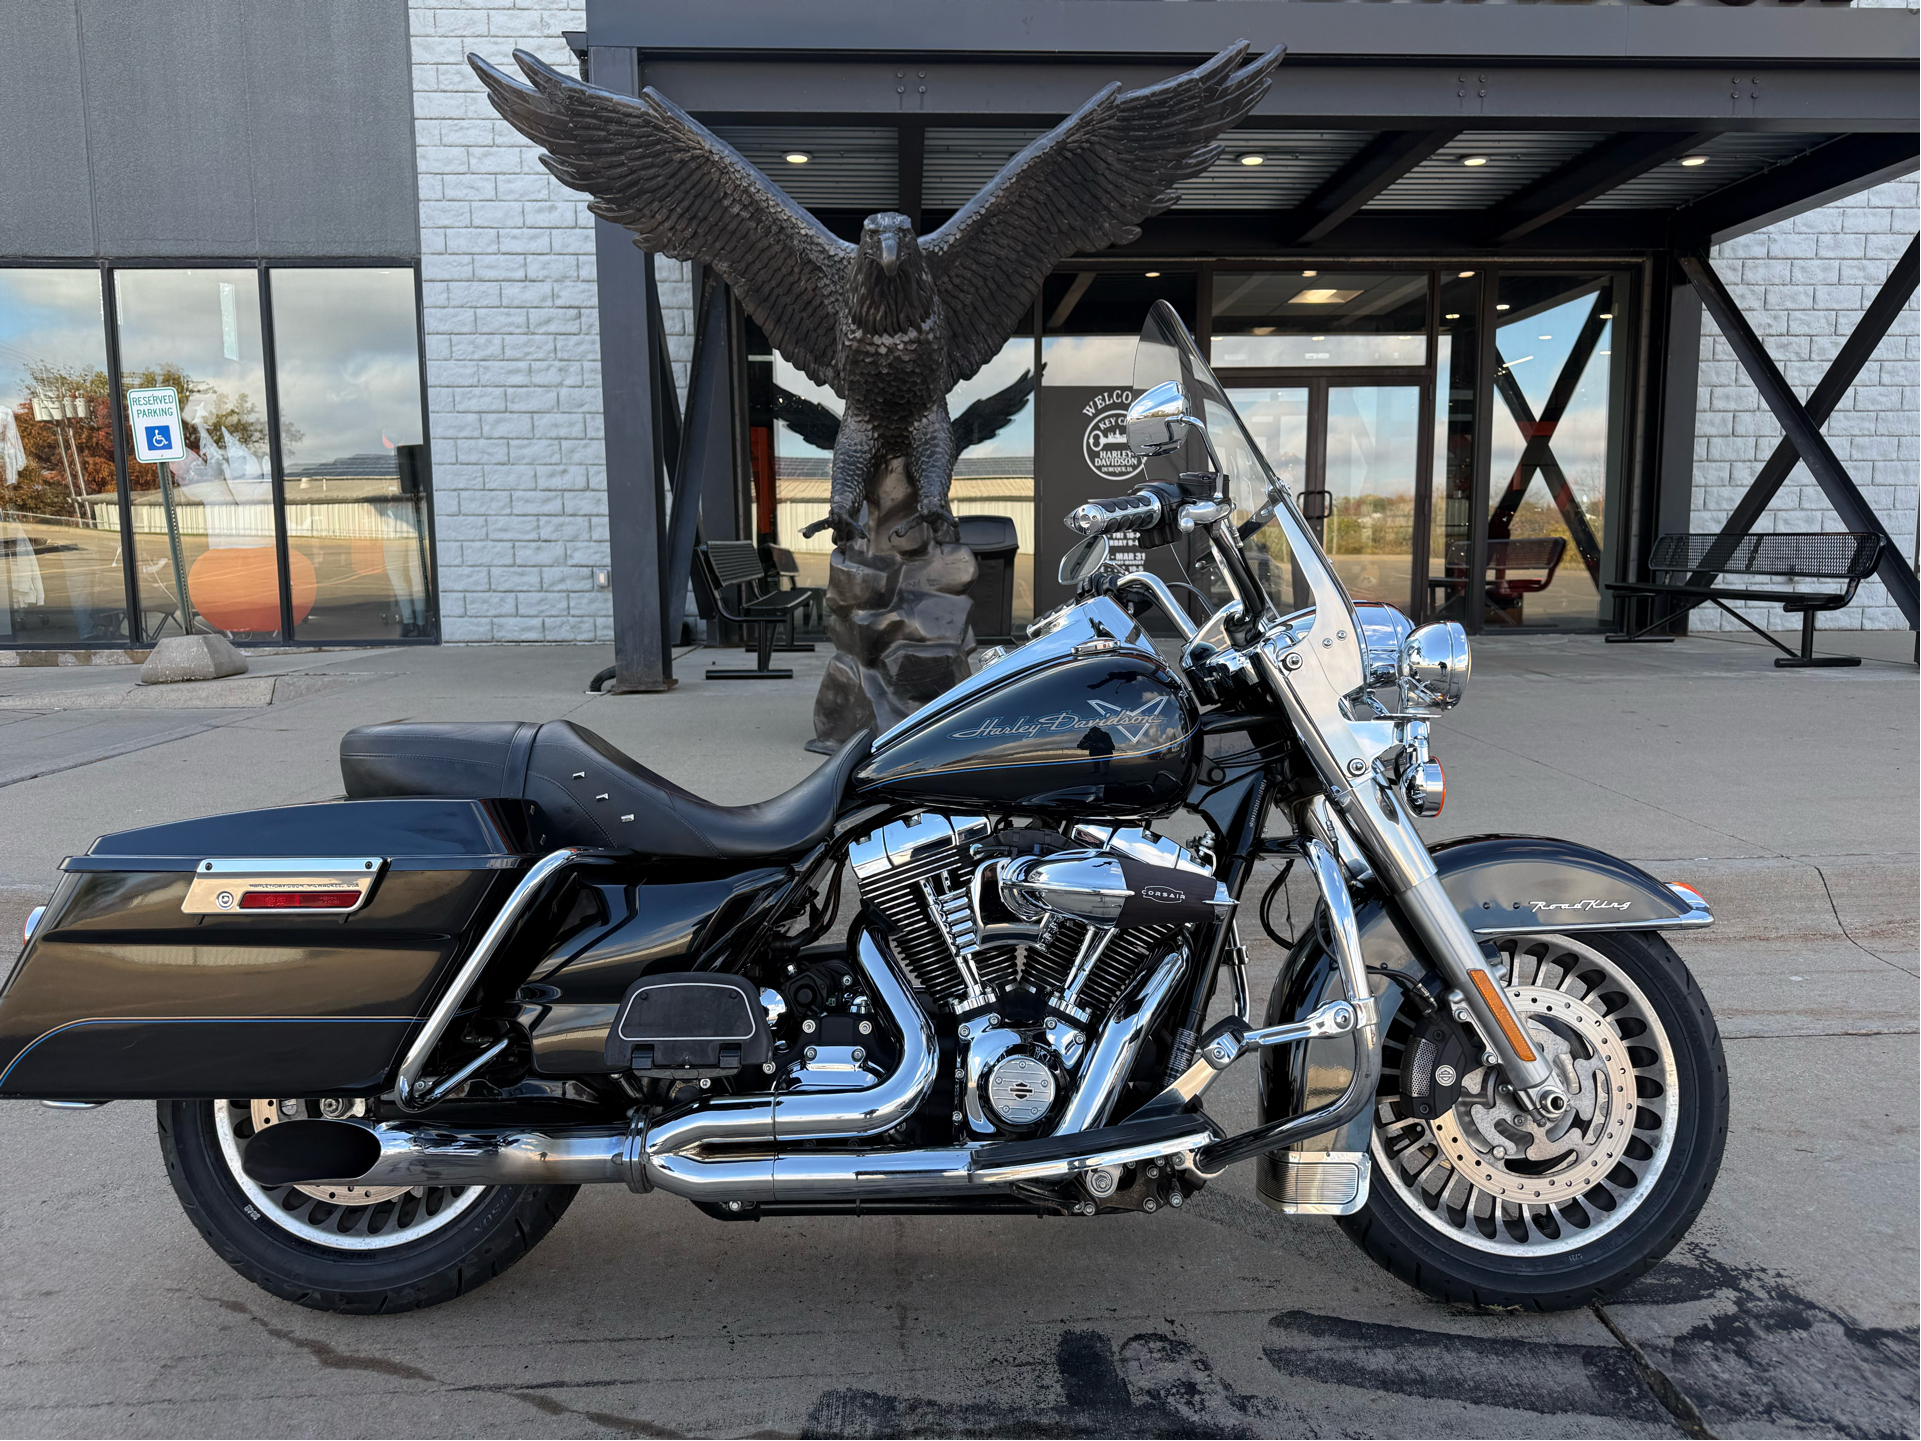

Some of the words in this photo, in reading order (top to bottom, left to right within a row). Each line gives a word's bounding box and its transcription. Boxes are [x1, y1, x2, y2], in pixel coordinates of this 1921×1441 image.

[132, 395, 174, 406] RESERVED
[1082, 390, 1133, 417] WELCO
[137, 407, 173, 418] PARKING
[1098, 417, 1116, 430] KEY
[1118, 417, 1128, 426] CI
[1094, 458, 1138, 466] DAVIDSON
[1115, 552, 1134, 560] MAR
[1135, 552, 1146, 560] 31
[949, 709, 1168, 740] Harley-Davidson
[1141, 889, 1186, 900] CORSAIR
